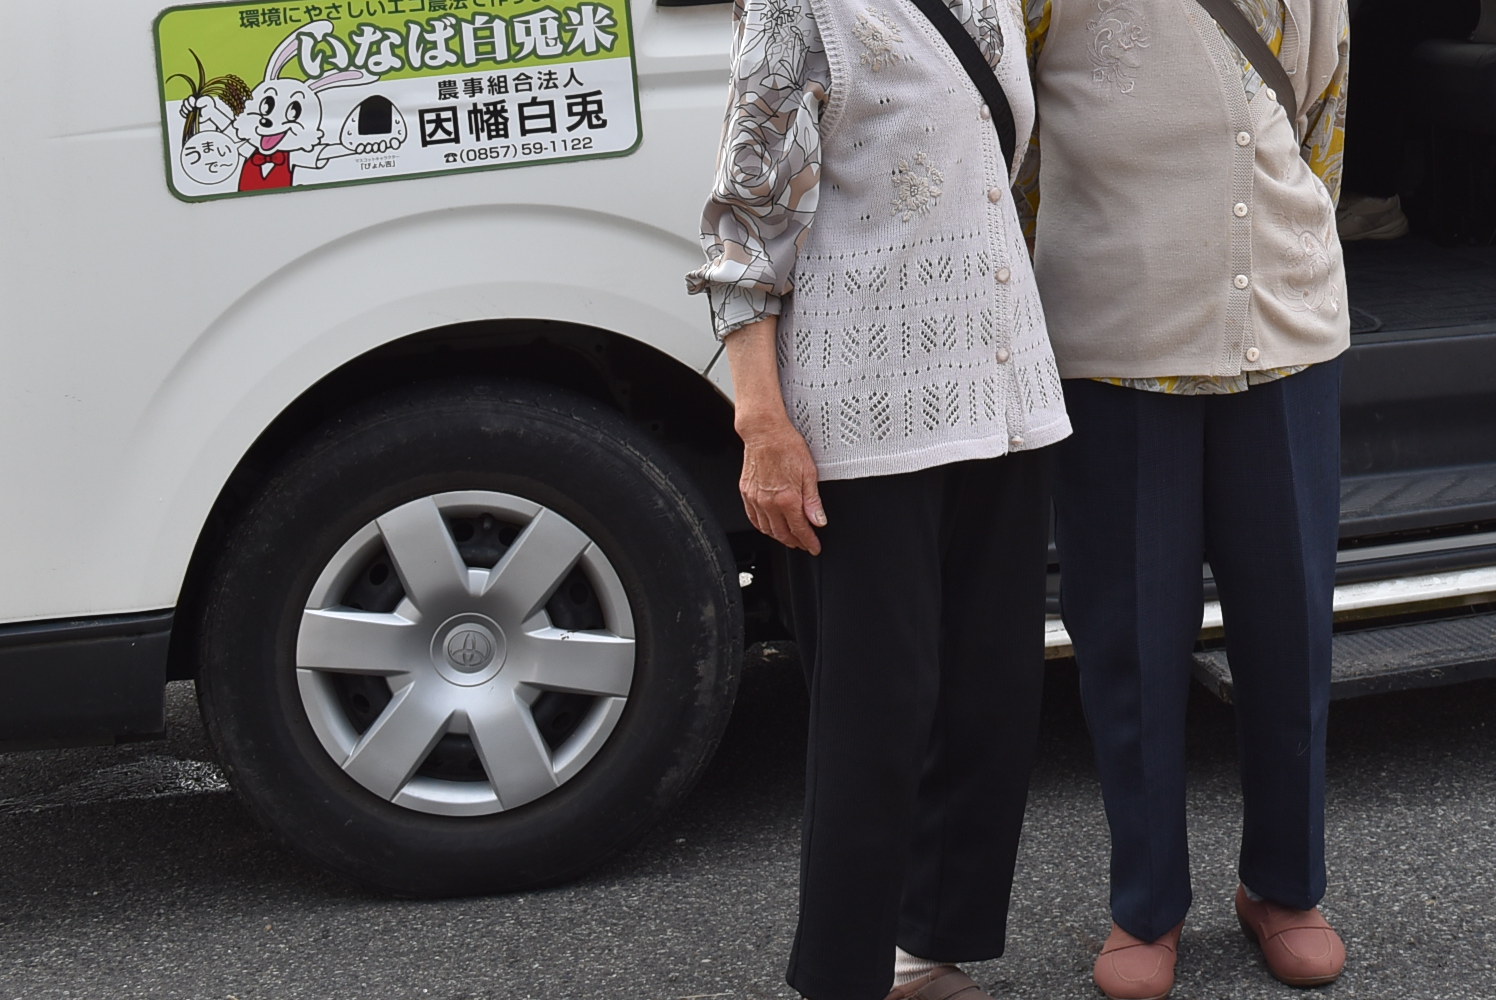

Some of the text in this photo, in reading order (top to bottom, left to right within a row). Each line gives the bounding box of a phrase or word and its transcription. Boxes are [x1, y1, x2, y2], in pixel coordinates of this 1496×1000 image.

[437, 67, 584, 101] 農事組合法人
[185, 141, 232, 165] うまい
